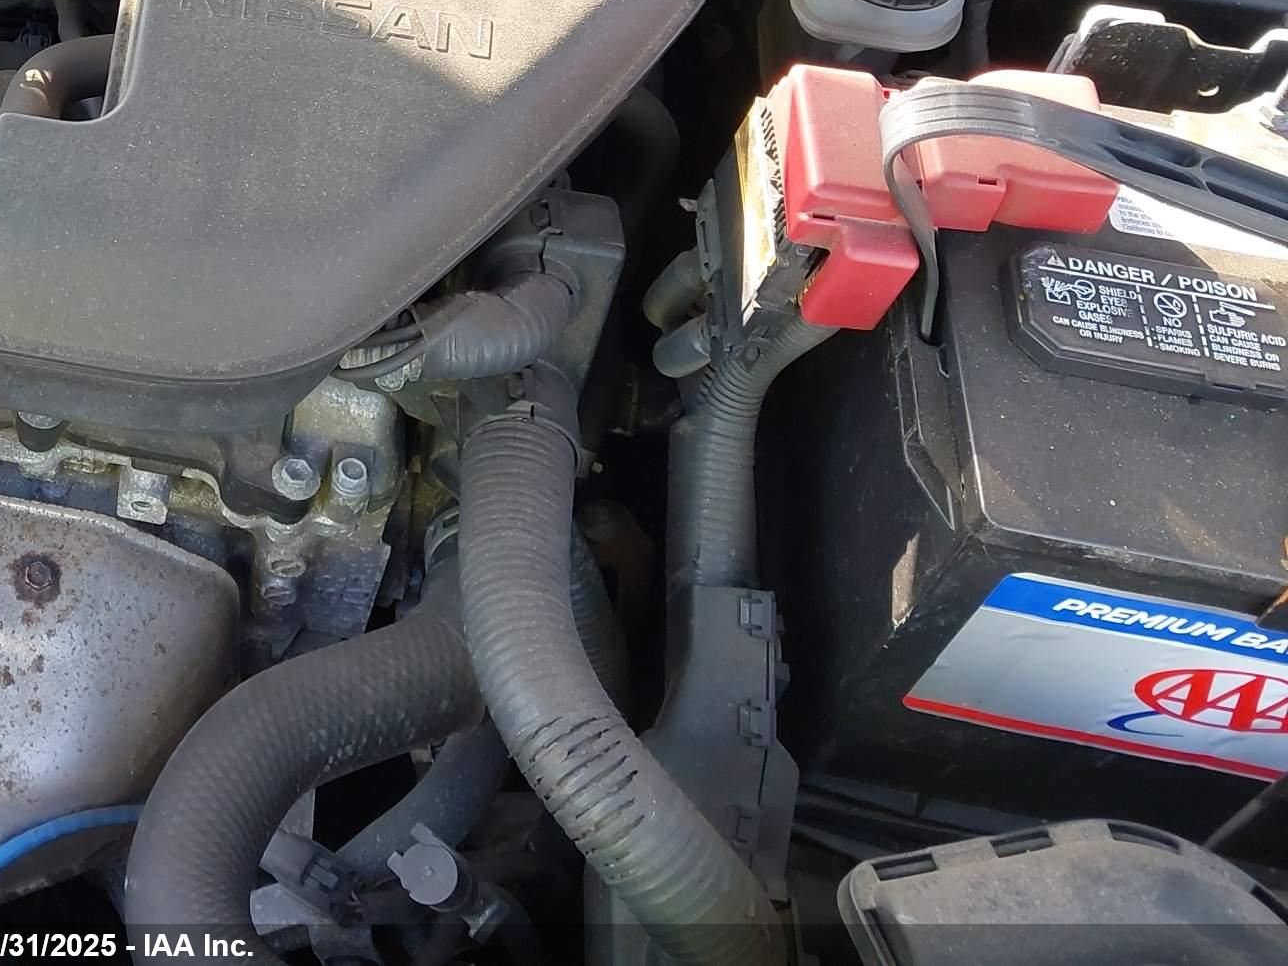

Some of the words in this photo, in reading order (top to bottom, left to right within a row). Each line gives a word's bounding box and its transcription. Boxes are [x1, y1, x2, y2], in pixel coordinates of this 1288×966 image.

[1068, 257, 1156, 284] DANGER
[1160, 274, 1172, 286] /
[1178, 275, 1258, 302] POISON
[1098, 285, 1138, 300] SHIELD
[1100, 295, 1128, 308] EYES
[1076, 300, 1134, 318] EXPLOSIVE
[1078, 310, 1113, 324] GASES
[1052, 316, 1070, 326] CAN
[1071, 319, 1098, 331] CAUSE
[1100, 324, 1145, 340] BLINDNESS
[1163, 316, 1182, 328] NO
[1079, 329, 1092, 338] OR
[1094, 332, 1124, 344] INJURY
[1206, 324, 1259, 342] SULFURIC
[1260, 334, 1287, 347] ACID
[1209, 334, 1229, 345] CAN
[1230, 338, 1262, 352] CAUSE
[1211, 342, 1262, 360] BLINDNESS
[1264, 352, 1280, 362] OR
[1214, 352, 1248, 366] SEVERE
[1250, 359, 1281, 372] BURNS
[1052, 598, 1236, 642] PREMIUM
[1230, 632, 1288, 655] BA
